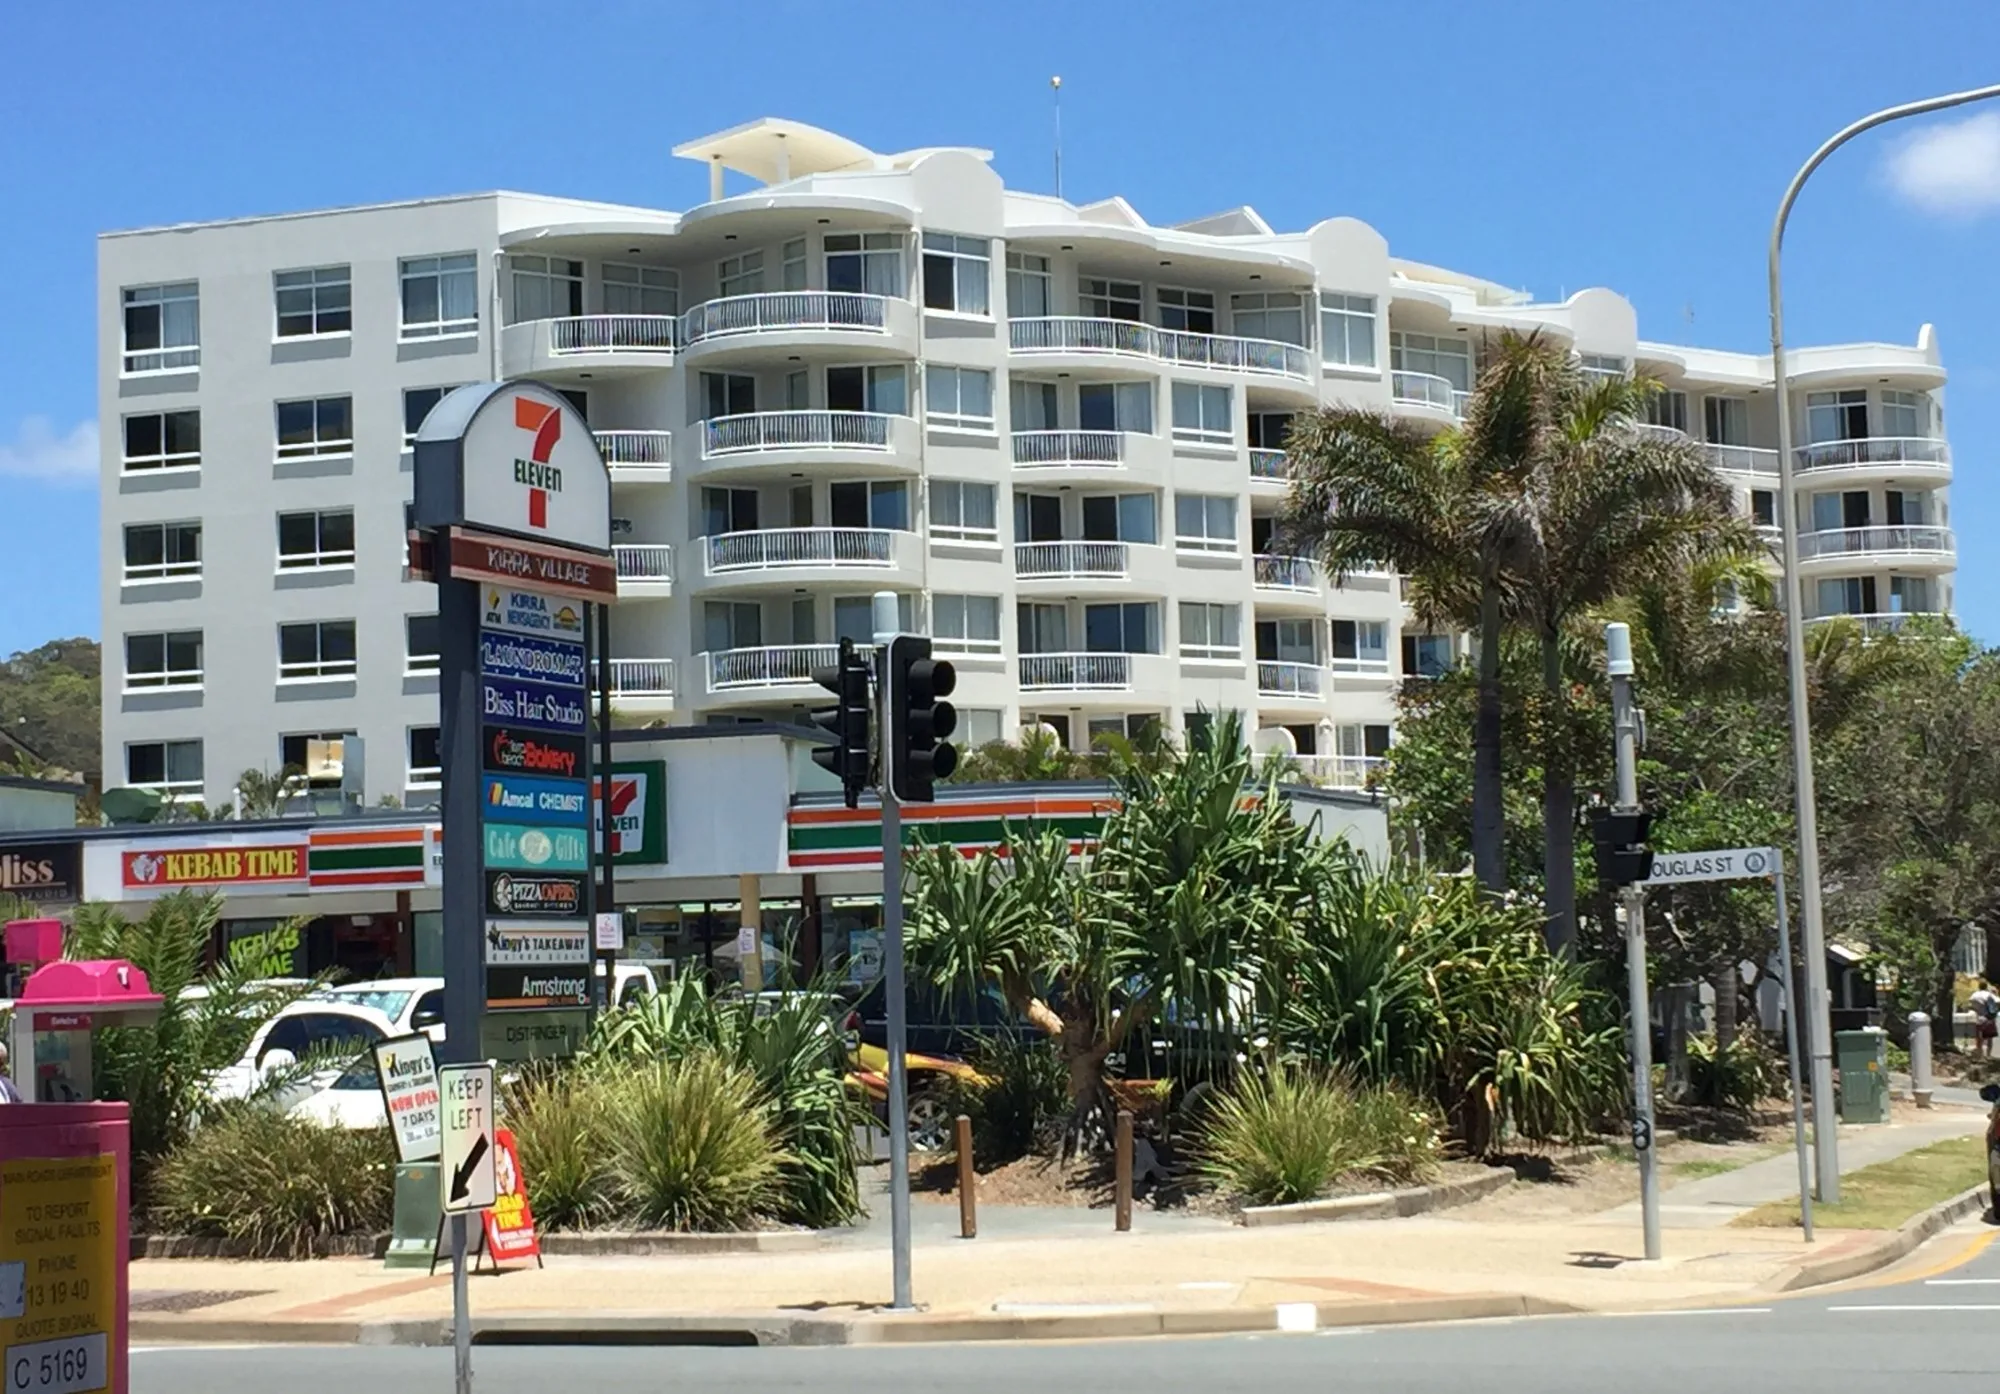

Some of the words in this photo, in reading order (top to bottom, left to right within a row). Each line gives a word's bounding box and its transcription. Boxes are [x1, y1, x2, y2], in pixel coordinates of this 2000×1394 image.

[487, 547, 532, 574] KIRRA
[537, 557, 591, 585] VILLAGE
[510, 592, 547, 612] KIRRA
[484, 685, 515, 716] Bliss
[516, 690, 544, 720] Hair
[545, 694, 584, 724] Studio
[524, 741, 575, 776] Bakery
[502, 789, 534, 808] Amcal
[539, 792, 584, 812] CHEMIST
[490, 830, 516, 858] Cafe
[555, 833, 585, 861] Gifts
[0, 854, 54, 888] liss
[166, 851, 242, 881] KEBAB
[244, 849, 299, 877] TIME
[1651, 857, 1712, 877] OUGLAS
[1715, 857, 1733, 873] ST
[512, 883, 542, 900] PIZZA
[532, 938, 585, 950] TAKEAWAY
[522, 976, 586, 1004] Armstrong
[388, 1052, 432, 1078] Kingy's
[390, 1094, 414, 1112] NOW
[415, 1089, 439, 1106] OPEN
[449, 1077, 484, 1101] KEEP
[402, 1115, 408, 1128] 7
[410, 1109, 435, 1126] DAYS
[450, 1108, 482, 1131] LEFT
[26, 1206, 42, 1221] TO
[45, 1201, 90, 1219] REPORT
[15, 1226, 56, 1245] SIGNAL
[59, 1220, 101, 1238] FAULTS
[38, 1254, 78, 1274] PHONE
[27, 1284, 45, 1307] 13
[51, 1280, 68, 1305] 19
[71, 1278, 90, 1301] 40
[15, 1317, 57, 1339] QUOTE
[58, 1312, 99, 1333] SIGNAL
[14, 1357, 31, 1390] C
[40, 1347, 88, 1385] 5169
